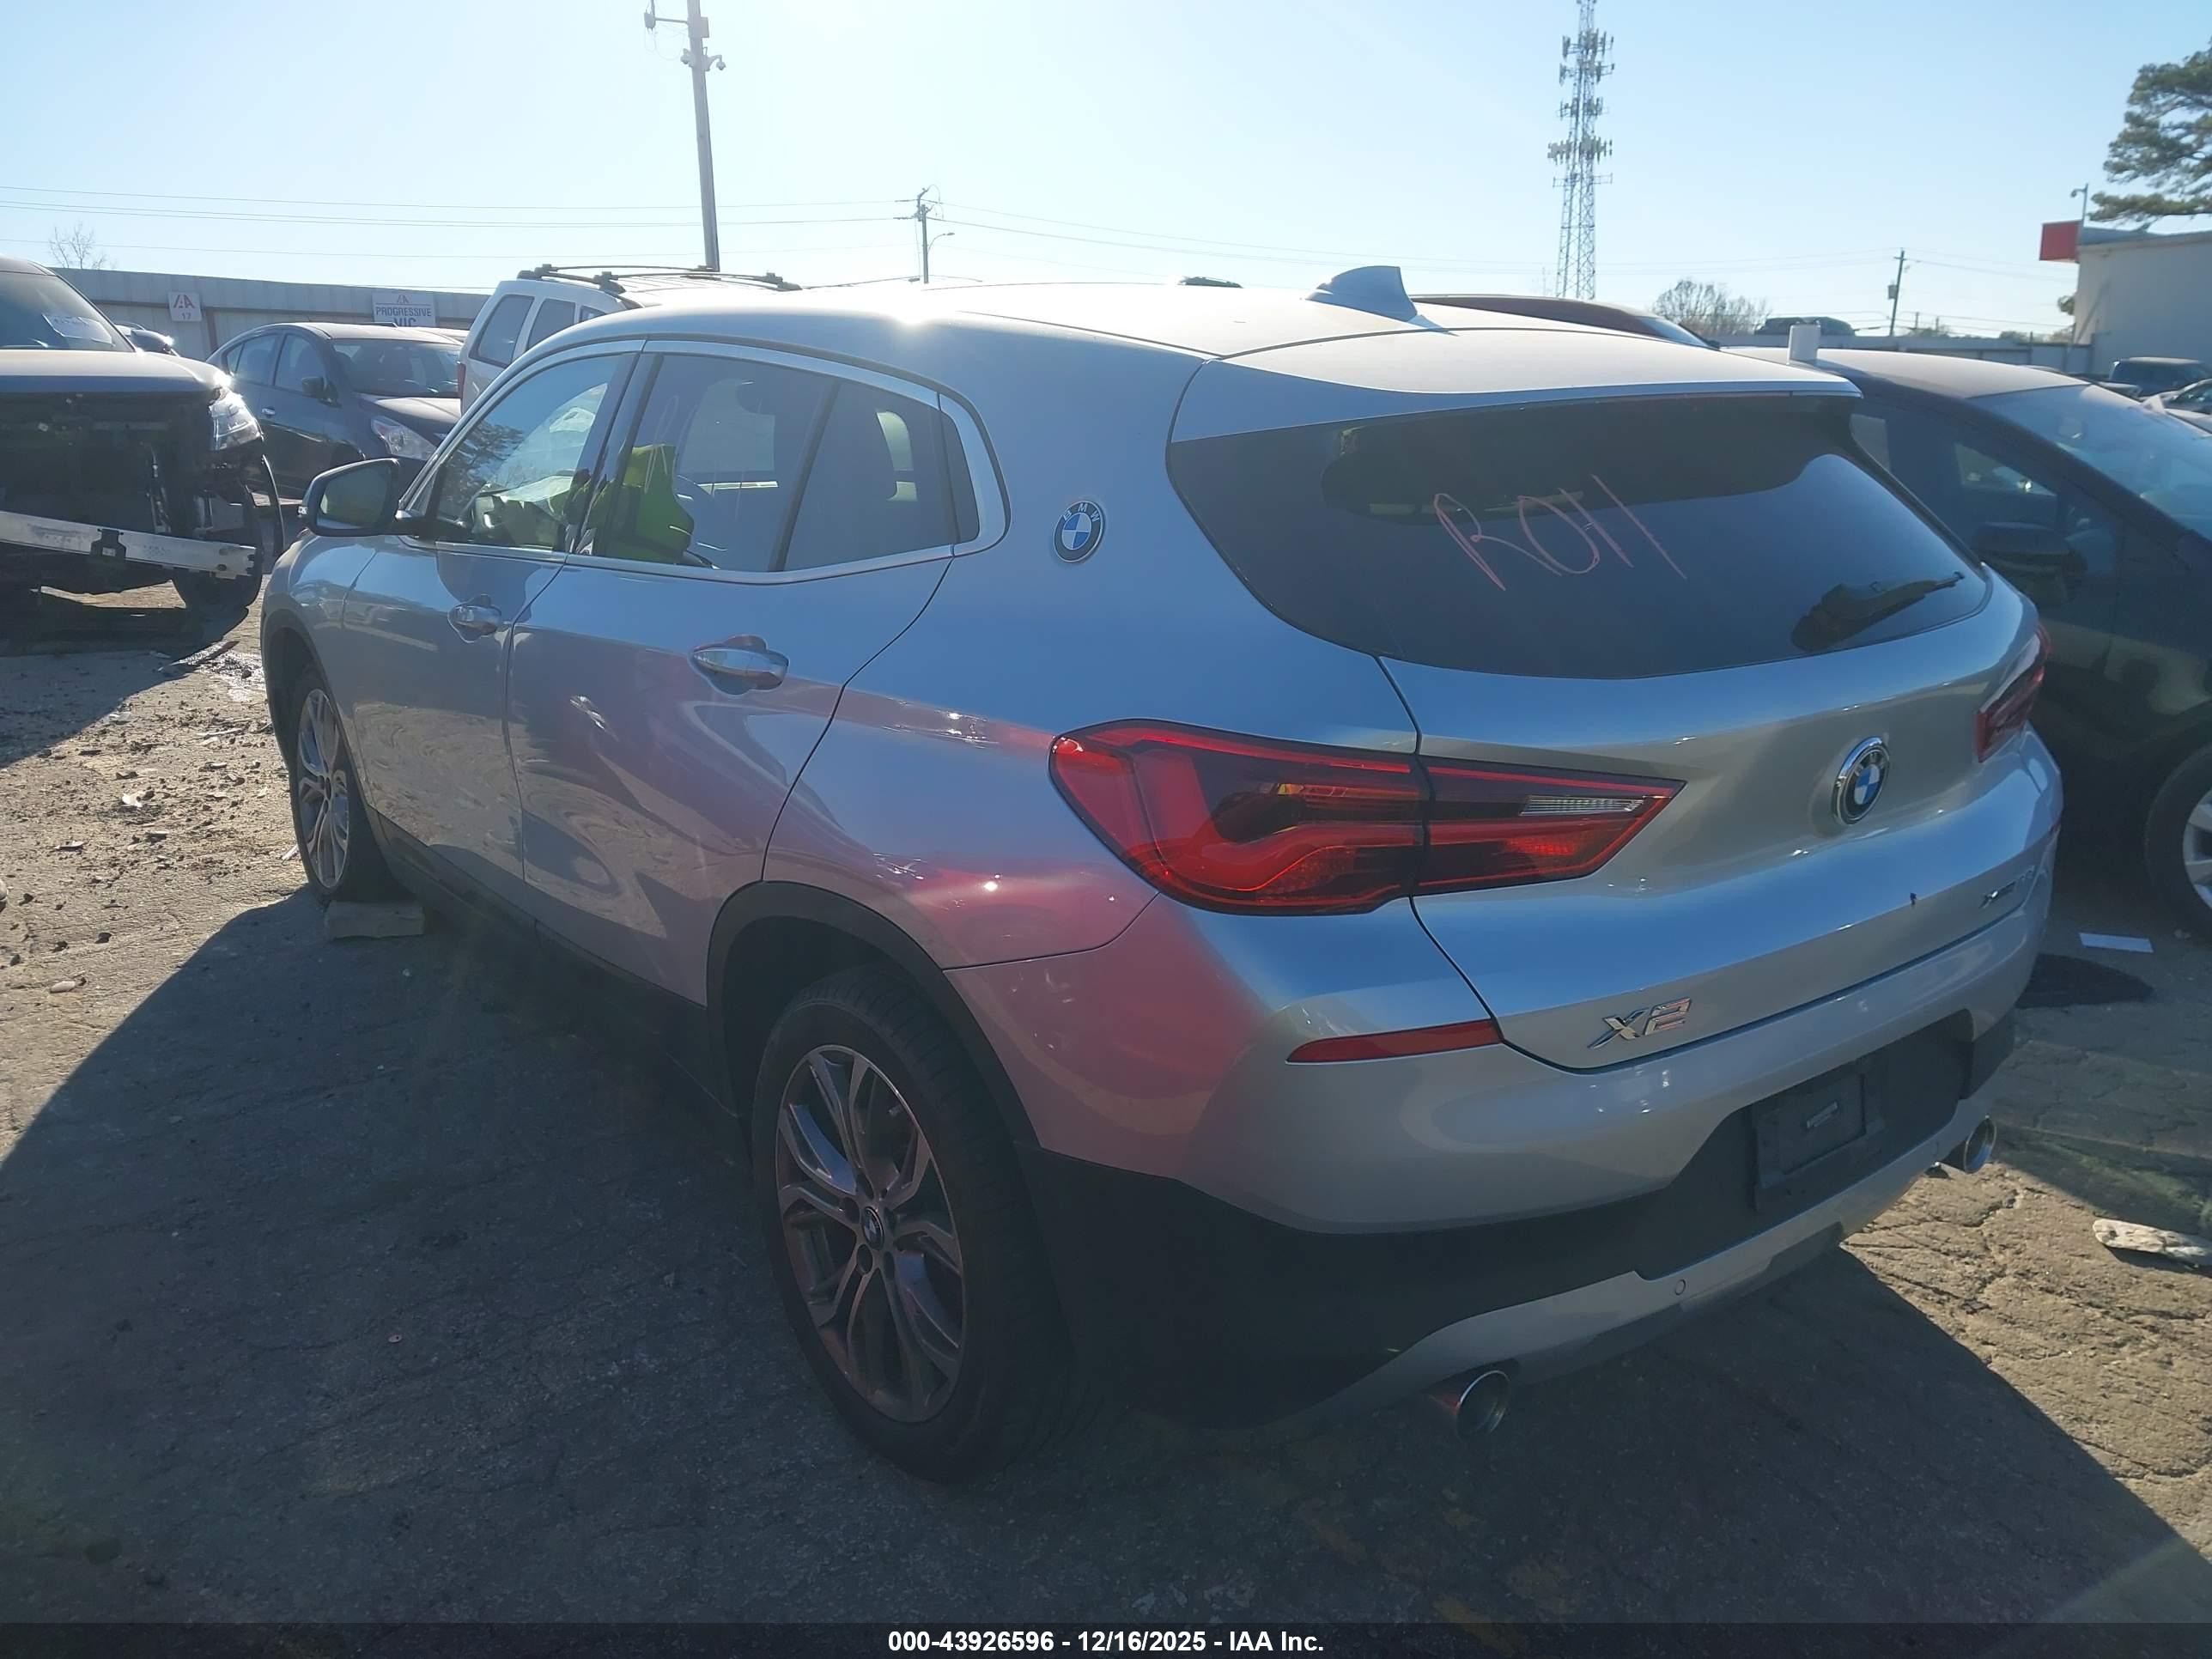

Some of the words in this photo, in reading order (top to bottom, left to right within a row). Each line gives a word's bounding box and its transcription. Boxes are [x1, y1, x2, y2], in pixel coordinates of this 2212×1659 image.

[375, 307, 432, 317] PROGRESSIVE
[1063, 502, 1100, 522] BMW
[1587, 997, 1692, 1049] X2
